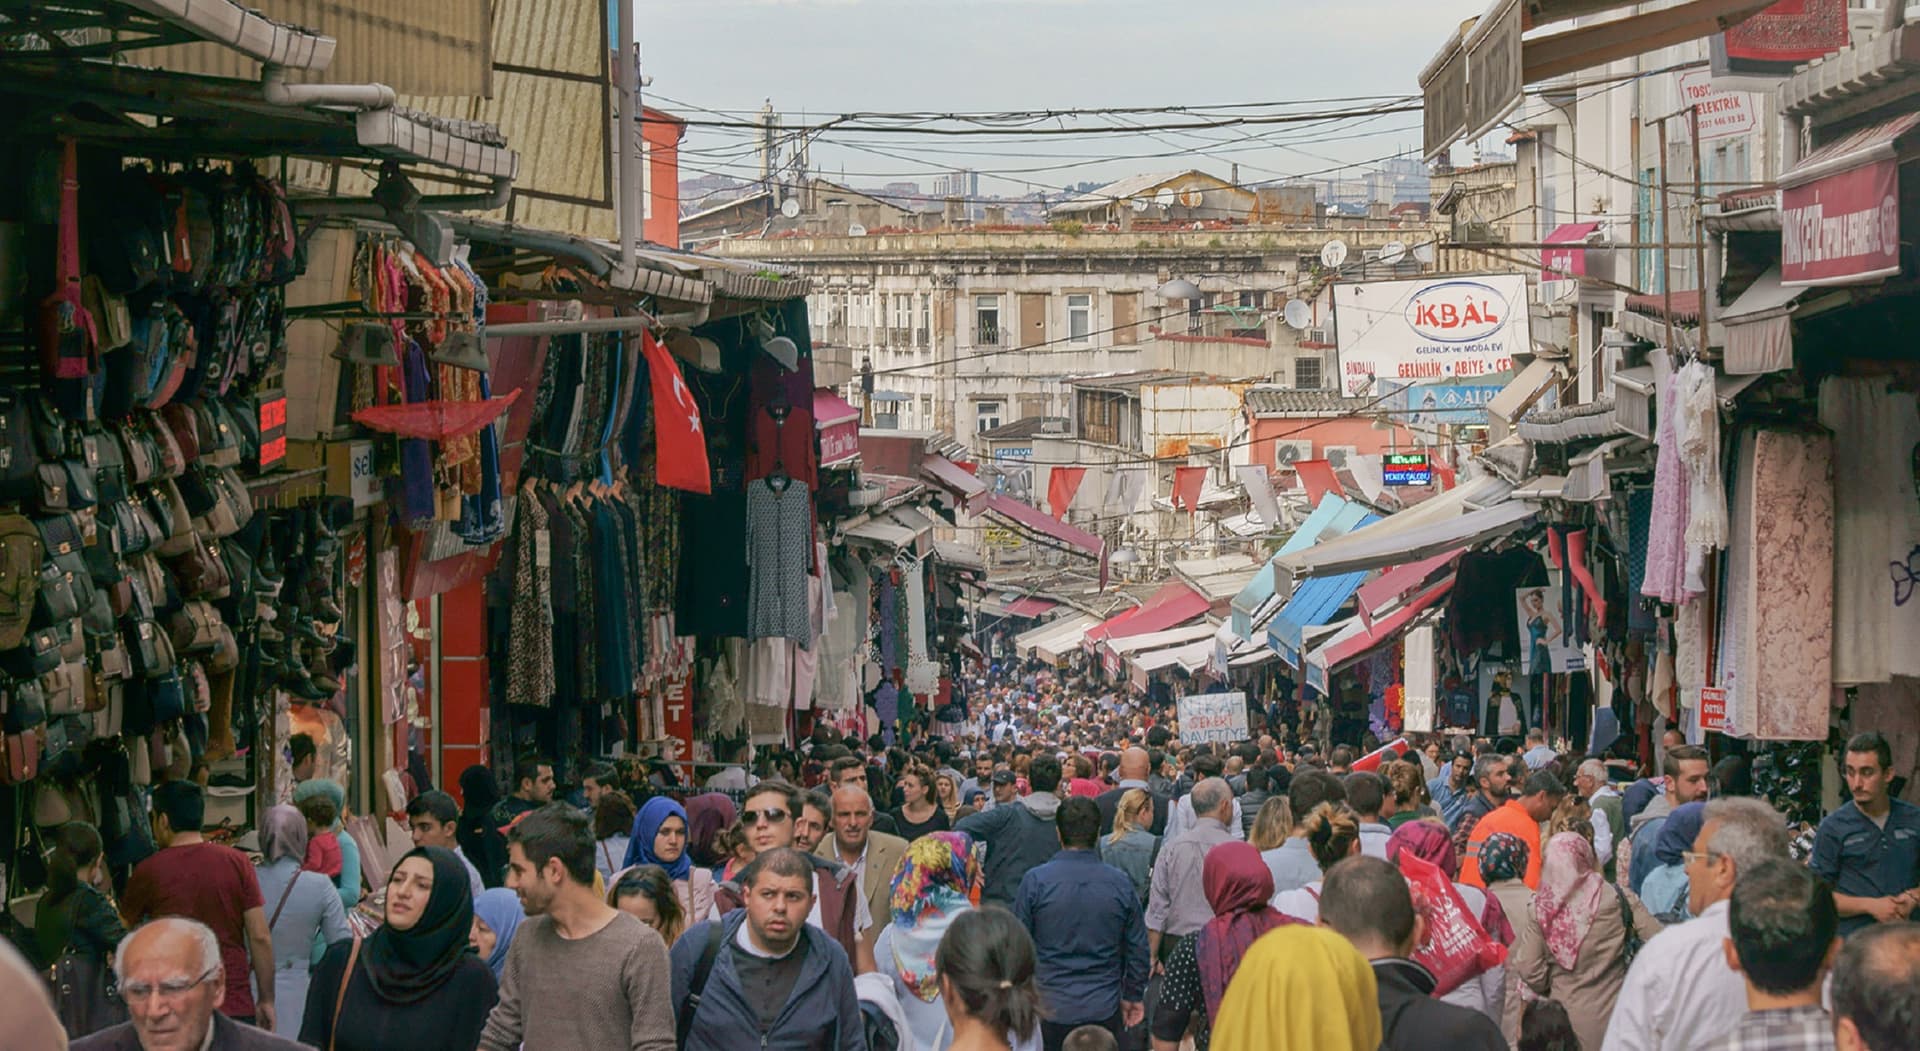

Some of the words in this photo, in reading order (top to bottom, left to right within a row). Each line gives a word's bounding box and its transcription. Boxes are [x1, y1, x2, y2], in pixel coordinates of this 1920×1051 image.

[1696, 94, 1741, 115] ELEKTRİK
[1415, 295, 1498, 328] İKBÂL
[1464, 344, 1490, 353] MODA
[1398, 358, 1442, 378] GELİNLİK
[1455, 357, 1484, 375] ABİYE
